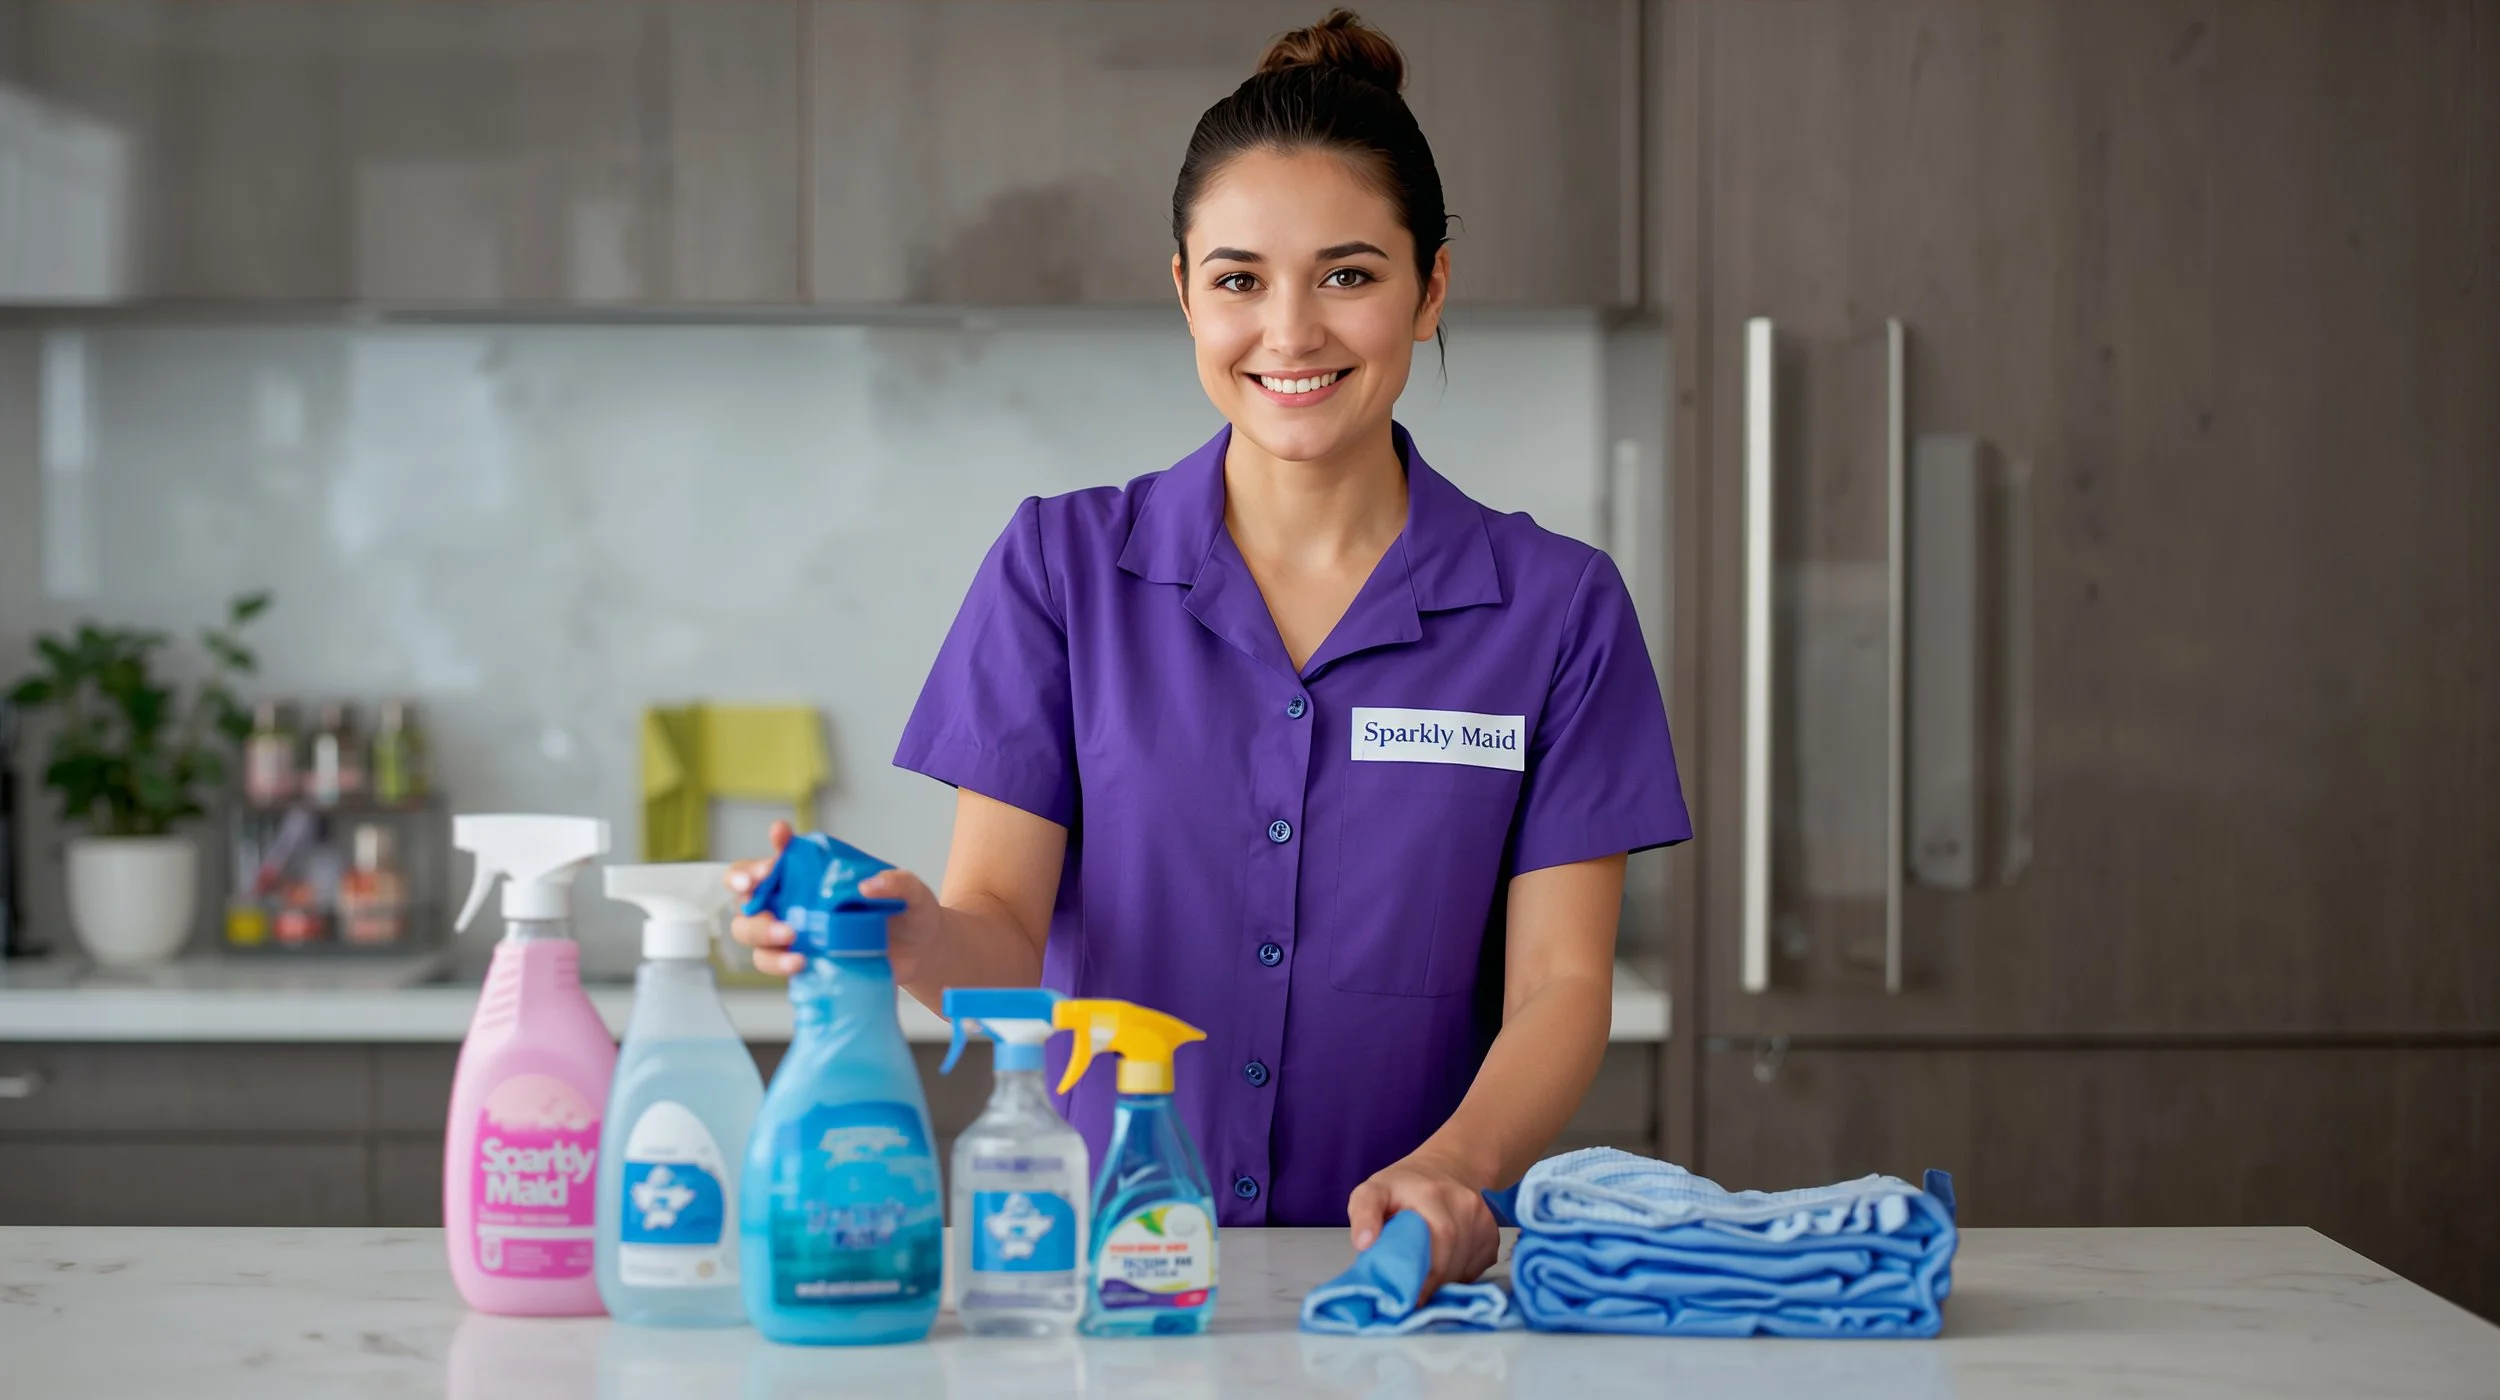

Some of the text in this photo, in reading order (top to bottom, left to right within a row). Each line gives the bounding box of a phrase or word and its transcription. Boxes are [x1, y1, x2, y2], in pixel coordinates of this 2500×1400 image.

[1364, 721, 1517, 750] Sparkly Maid
[485, 1173, 568, 1207] Maid
